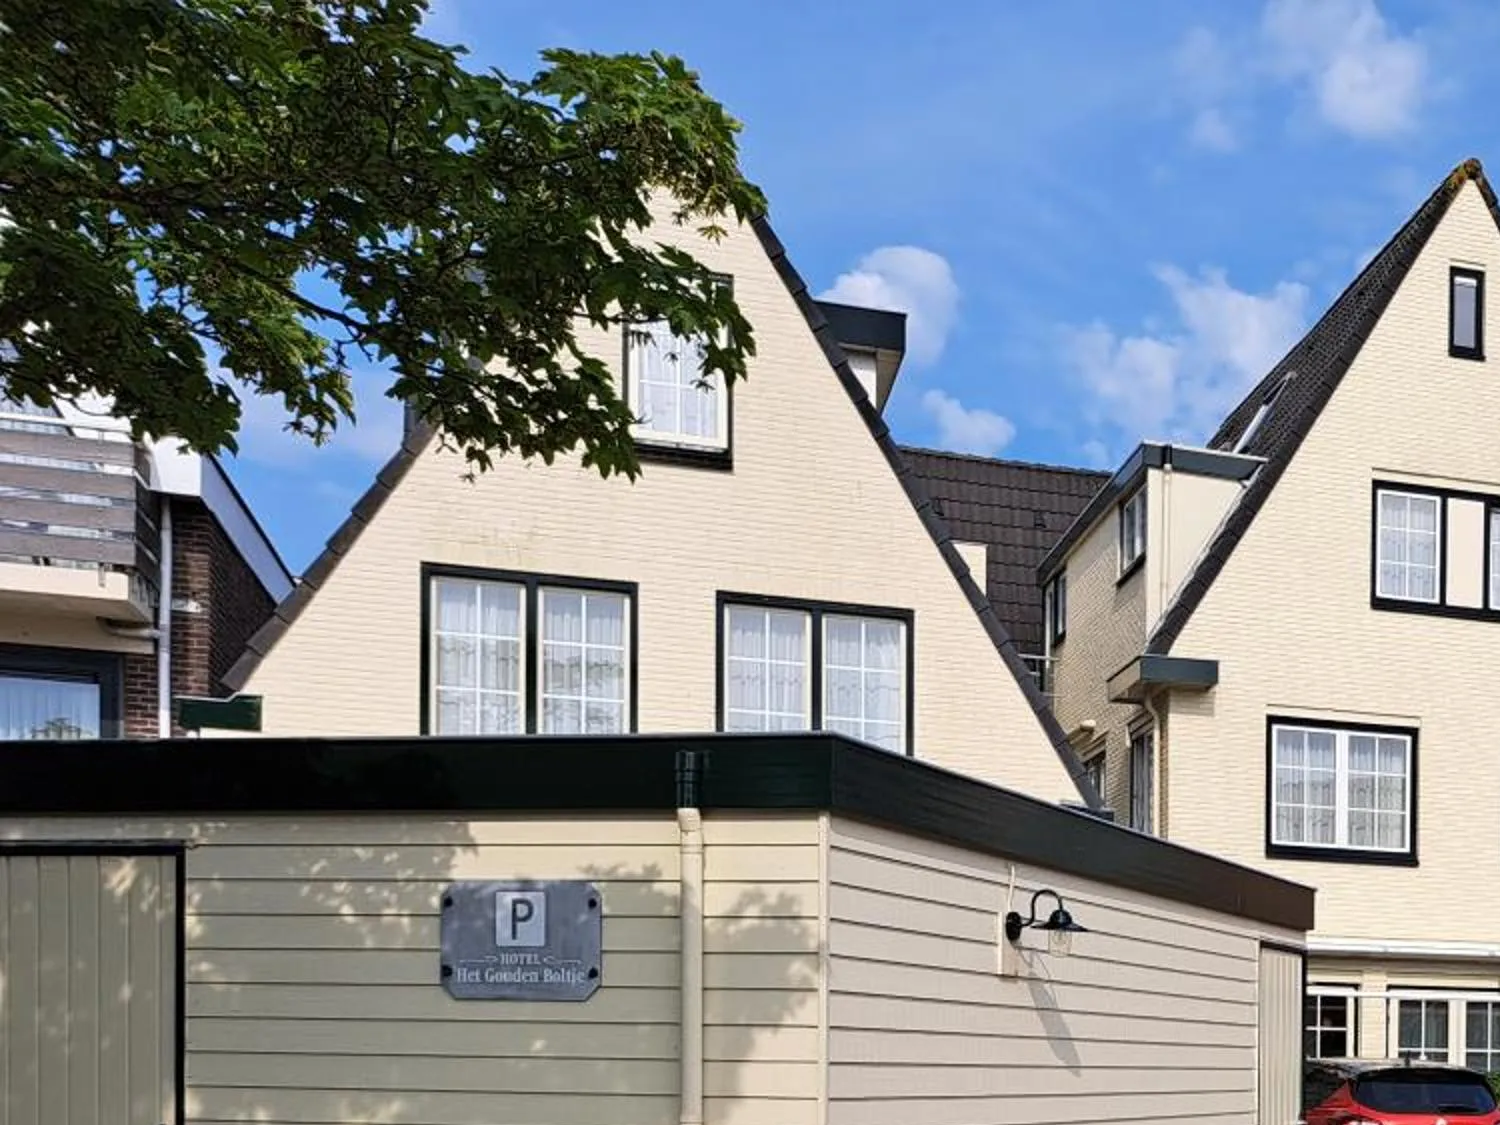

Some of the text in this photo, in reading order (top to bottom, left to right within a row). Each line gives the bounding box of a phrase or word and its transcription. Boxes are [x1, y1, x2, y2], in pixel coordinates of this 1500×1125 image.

[511, 898, 534, 940] P
[501, 953, 541, 965] HOTEL
[457, 967, 586, 986] Het Gouden Boltje
